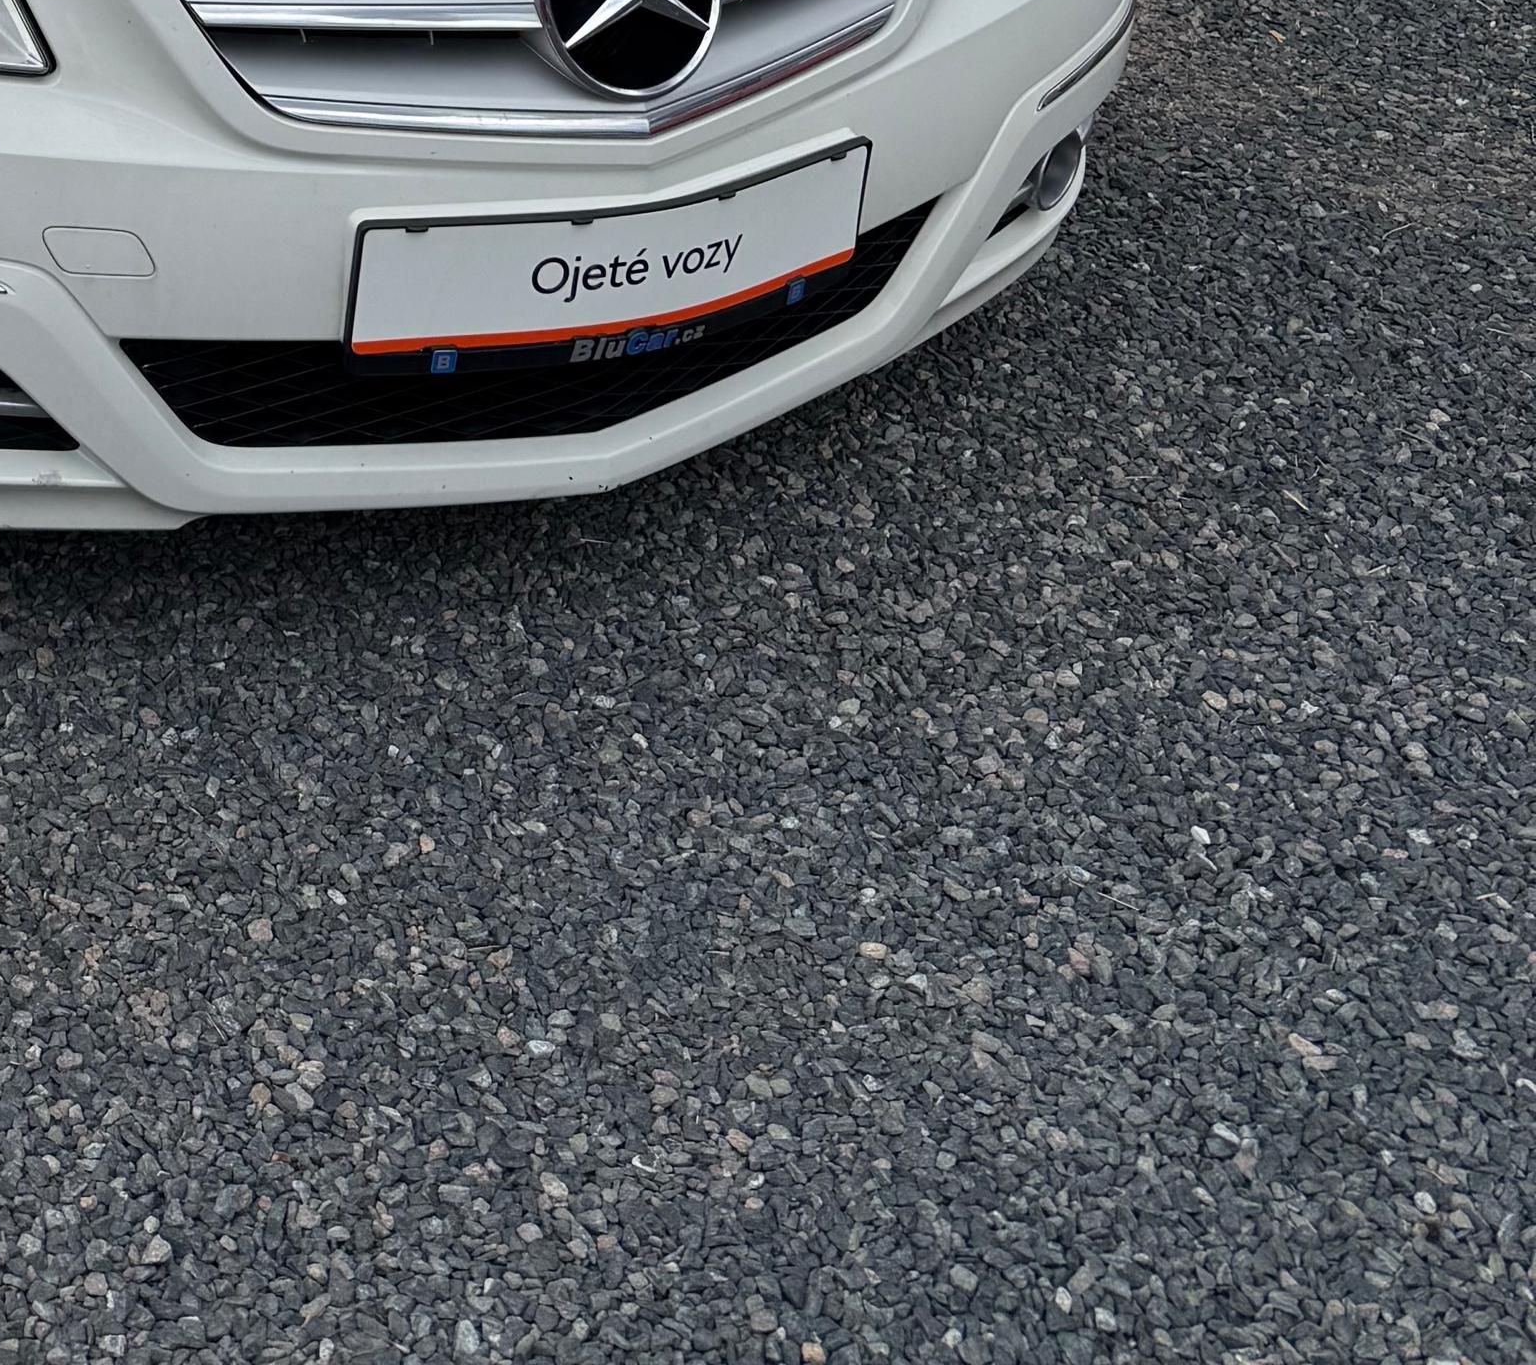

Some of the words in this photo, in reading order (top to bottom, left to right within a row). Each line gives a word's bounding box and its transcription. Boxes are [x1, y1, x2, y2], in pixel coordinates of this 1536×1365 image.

[531, 247, 650, 303] Ojeté
[662, 233, 743, 279] vozy
[569, 325, 706, 363] BluCar.cz
